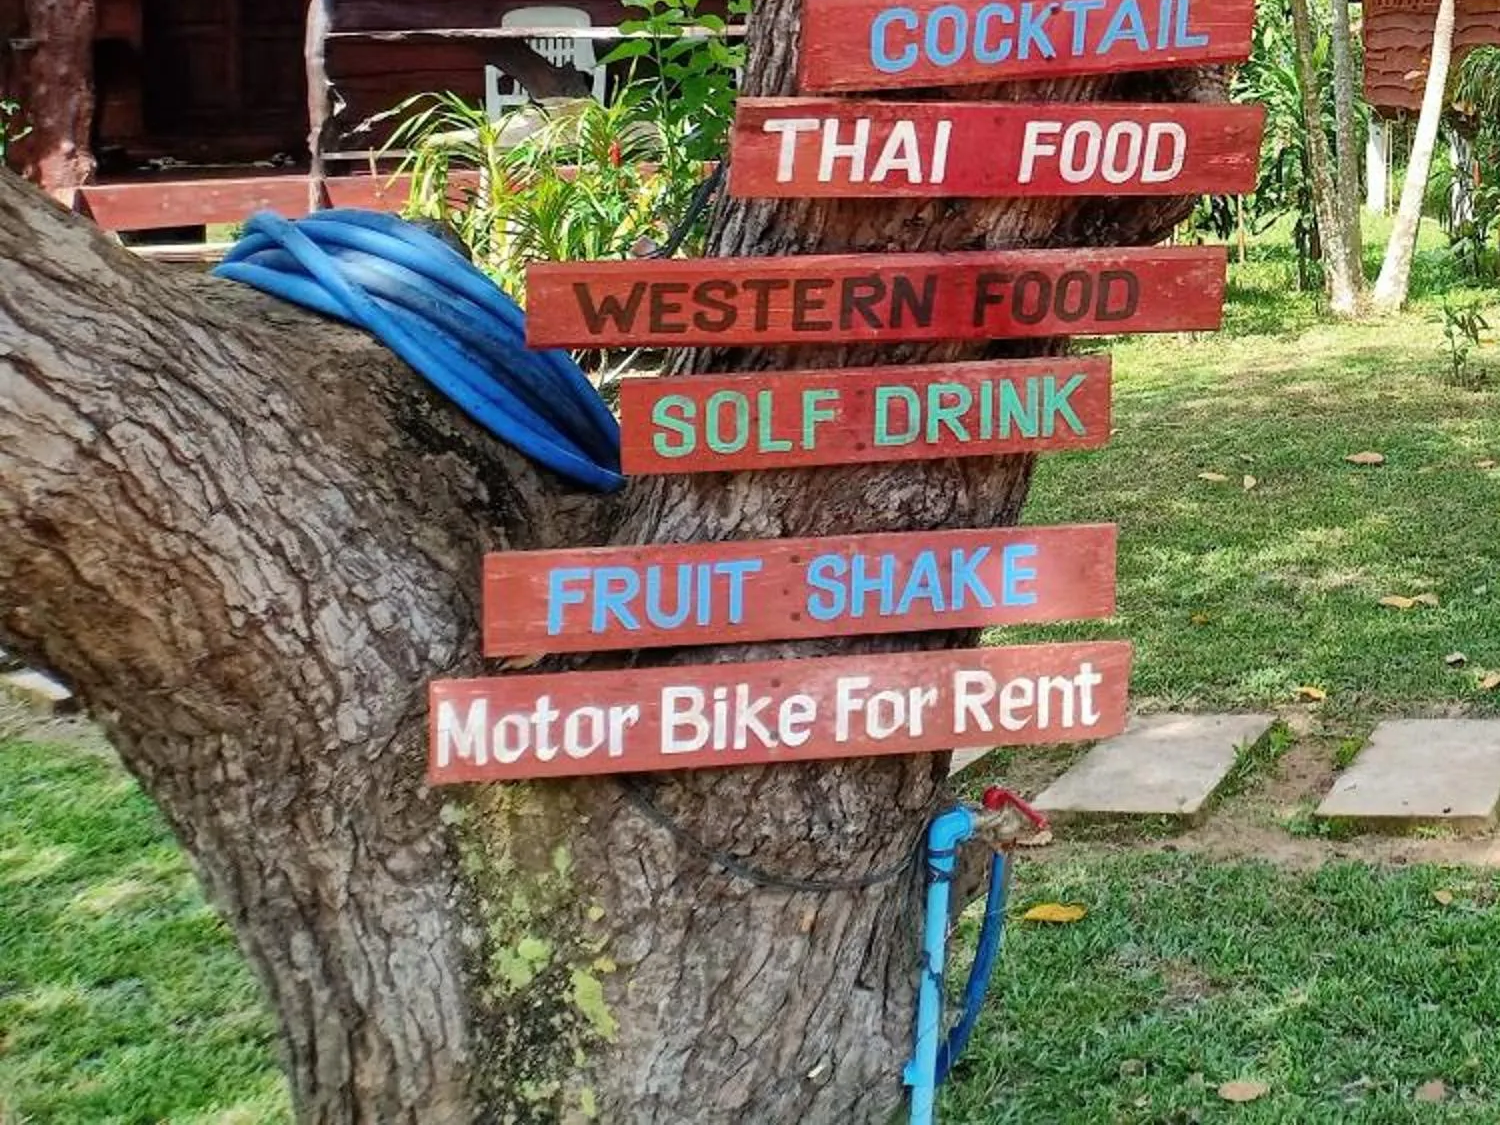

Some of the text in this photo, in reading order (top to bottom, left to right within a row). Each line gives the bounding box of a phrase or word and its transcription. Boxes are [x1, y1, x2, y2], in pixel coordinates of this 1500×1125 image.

[762, 117, 1188, 185] THAI FOOD
[573, 269, 1140, 336] WESTERN FOOD
[651, 372, 1087, 459] SOLF DRINK
[546, 543, 1039, 636] FRUIT SHAKE
[434, 661, 1103, 770] Motor Bike For Rent
